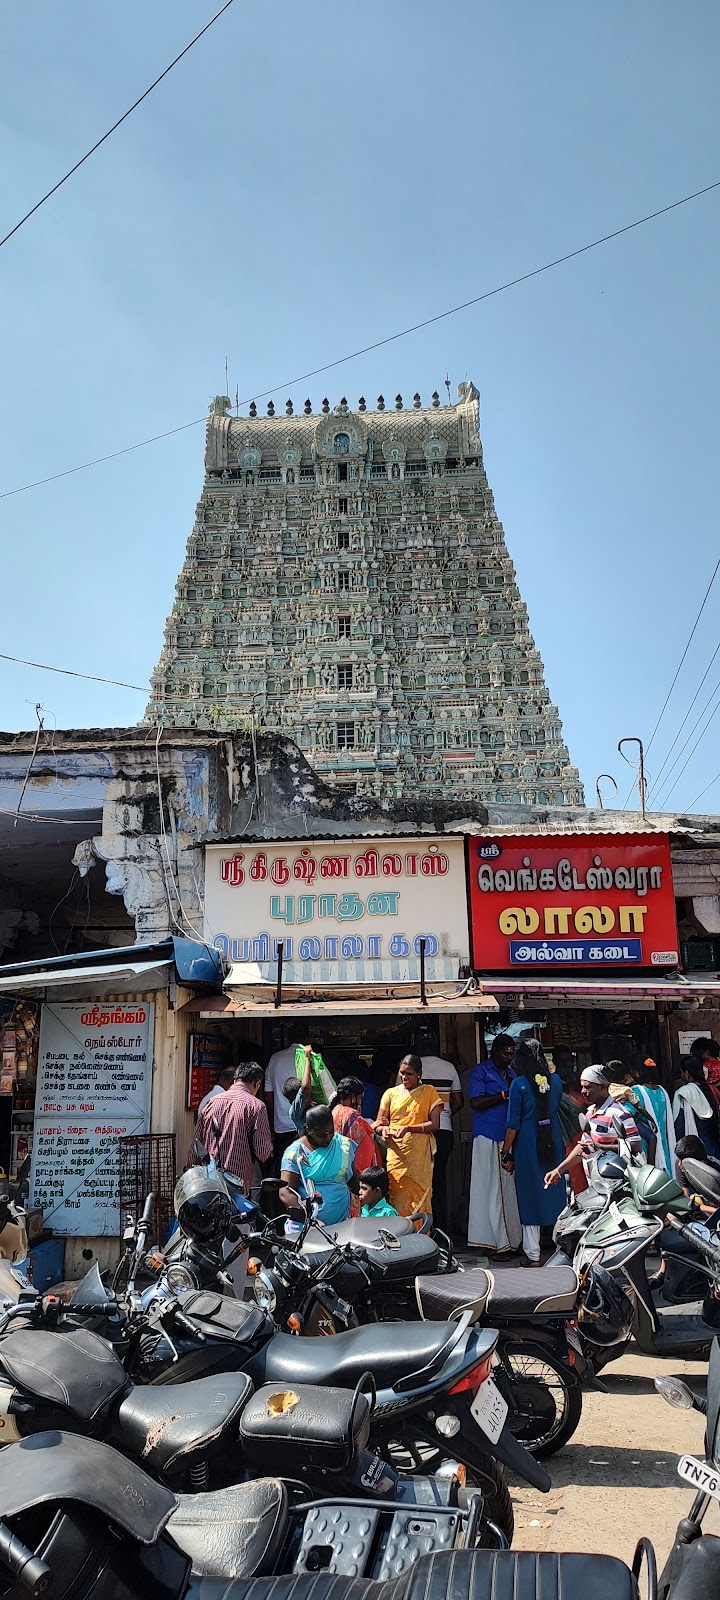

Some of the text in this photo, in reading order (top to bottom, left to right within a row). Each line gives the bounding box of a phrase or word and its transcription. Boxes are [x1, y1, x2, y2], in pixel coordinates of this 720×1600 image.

[477, 855, 663, 896] வெங்கடேஸ்வரா
[269, 891, 400, 924] புராதன
[498, 905, 648, 936] லாலா
[515, 942, 584, 961] அல்வா
[588, 945, 637, 960] கடை
[318, 1319, 333, 1327] TVS
[684, 1460, 718, 1492] TN76
